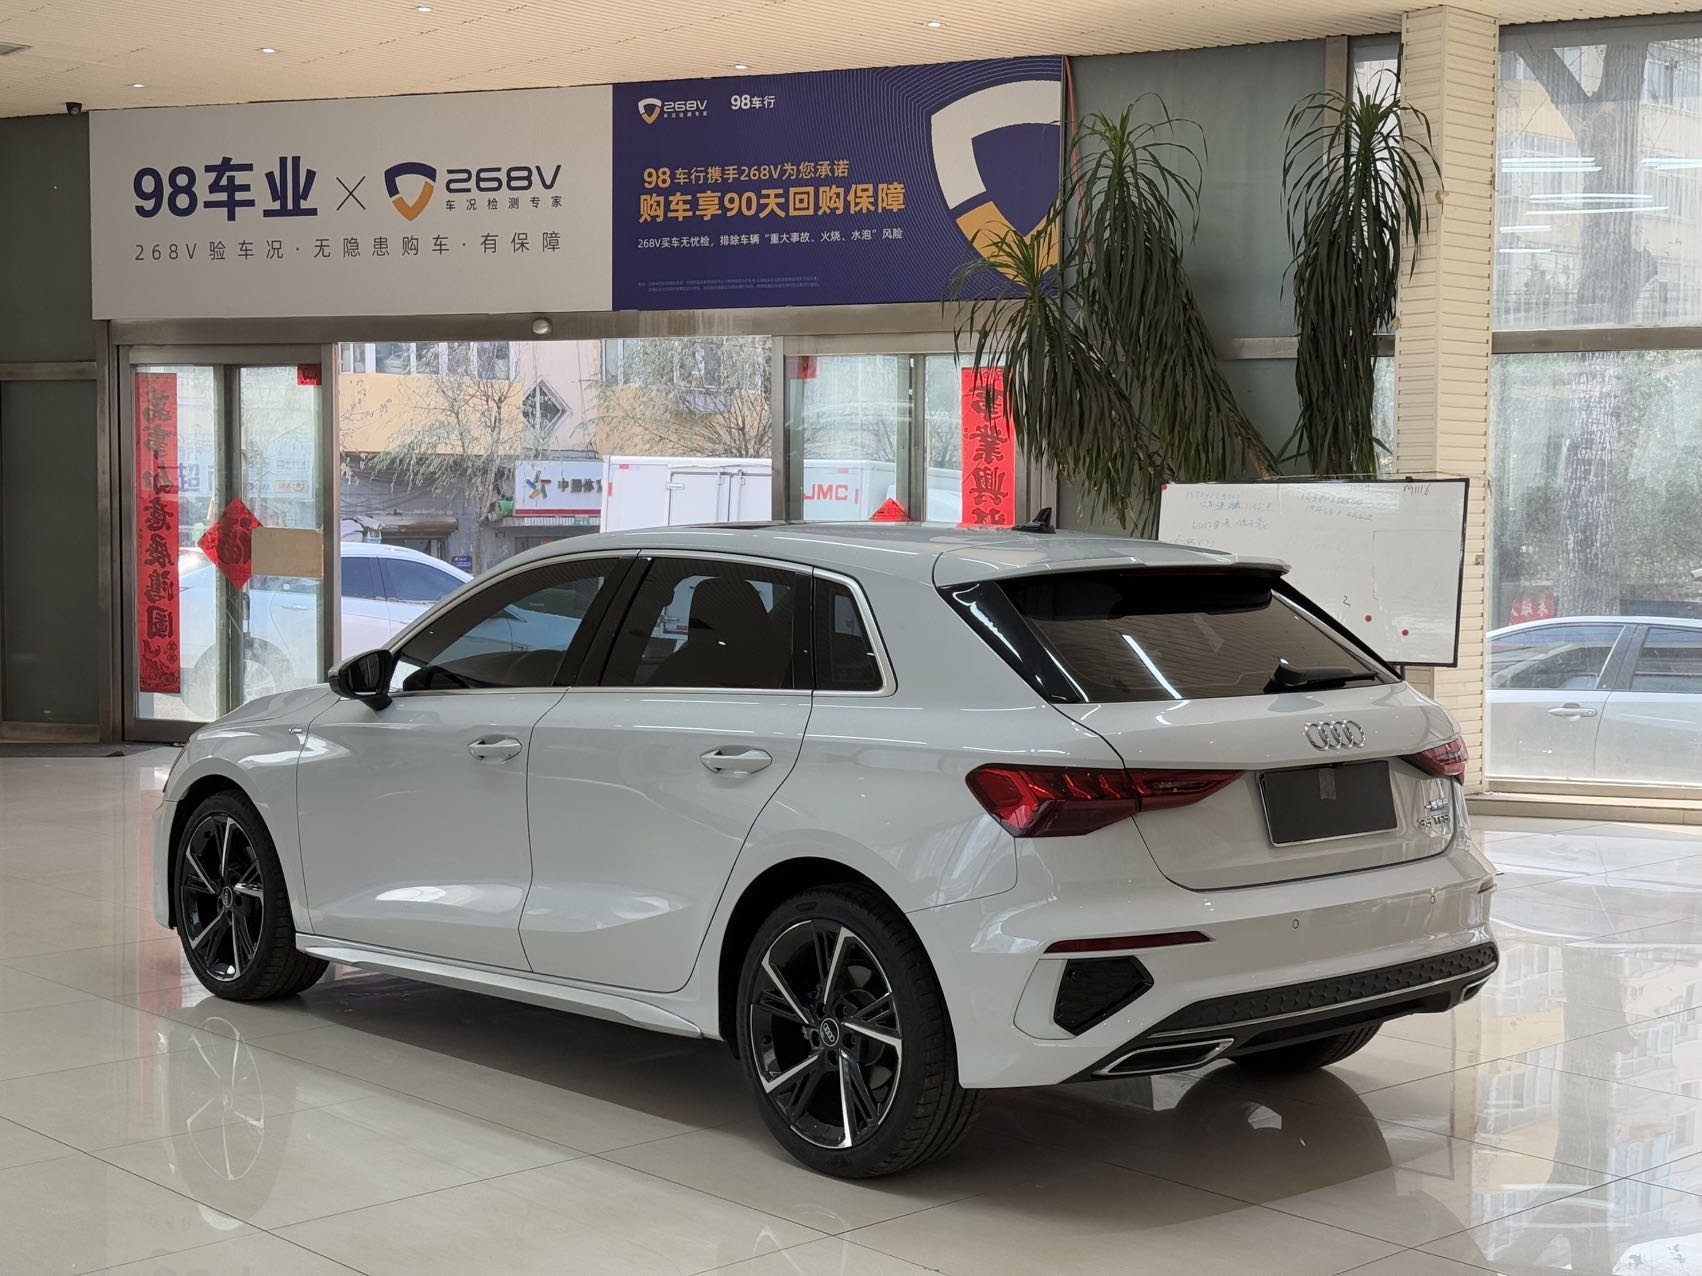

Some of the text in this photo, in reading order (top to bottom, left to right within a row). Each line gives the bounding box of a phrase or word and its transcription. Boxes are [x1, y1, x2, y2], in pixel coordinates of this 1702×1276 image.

[663, 99, 708, 112] 268V
[730, 94, 776, 110] 98车行
[133, 156, 318, 221] 98车业
[445, 164, 562, 193] 268V
[445, 195, 563, 212] 车况检测专家
[638, 182, 906, 224] 购车享90天回购保障
[803, 483, 848, 500] JMC
